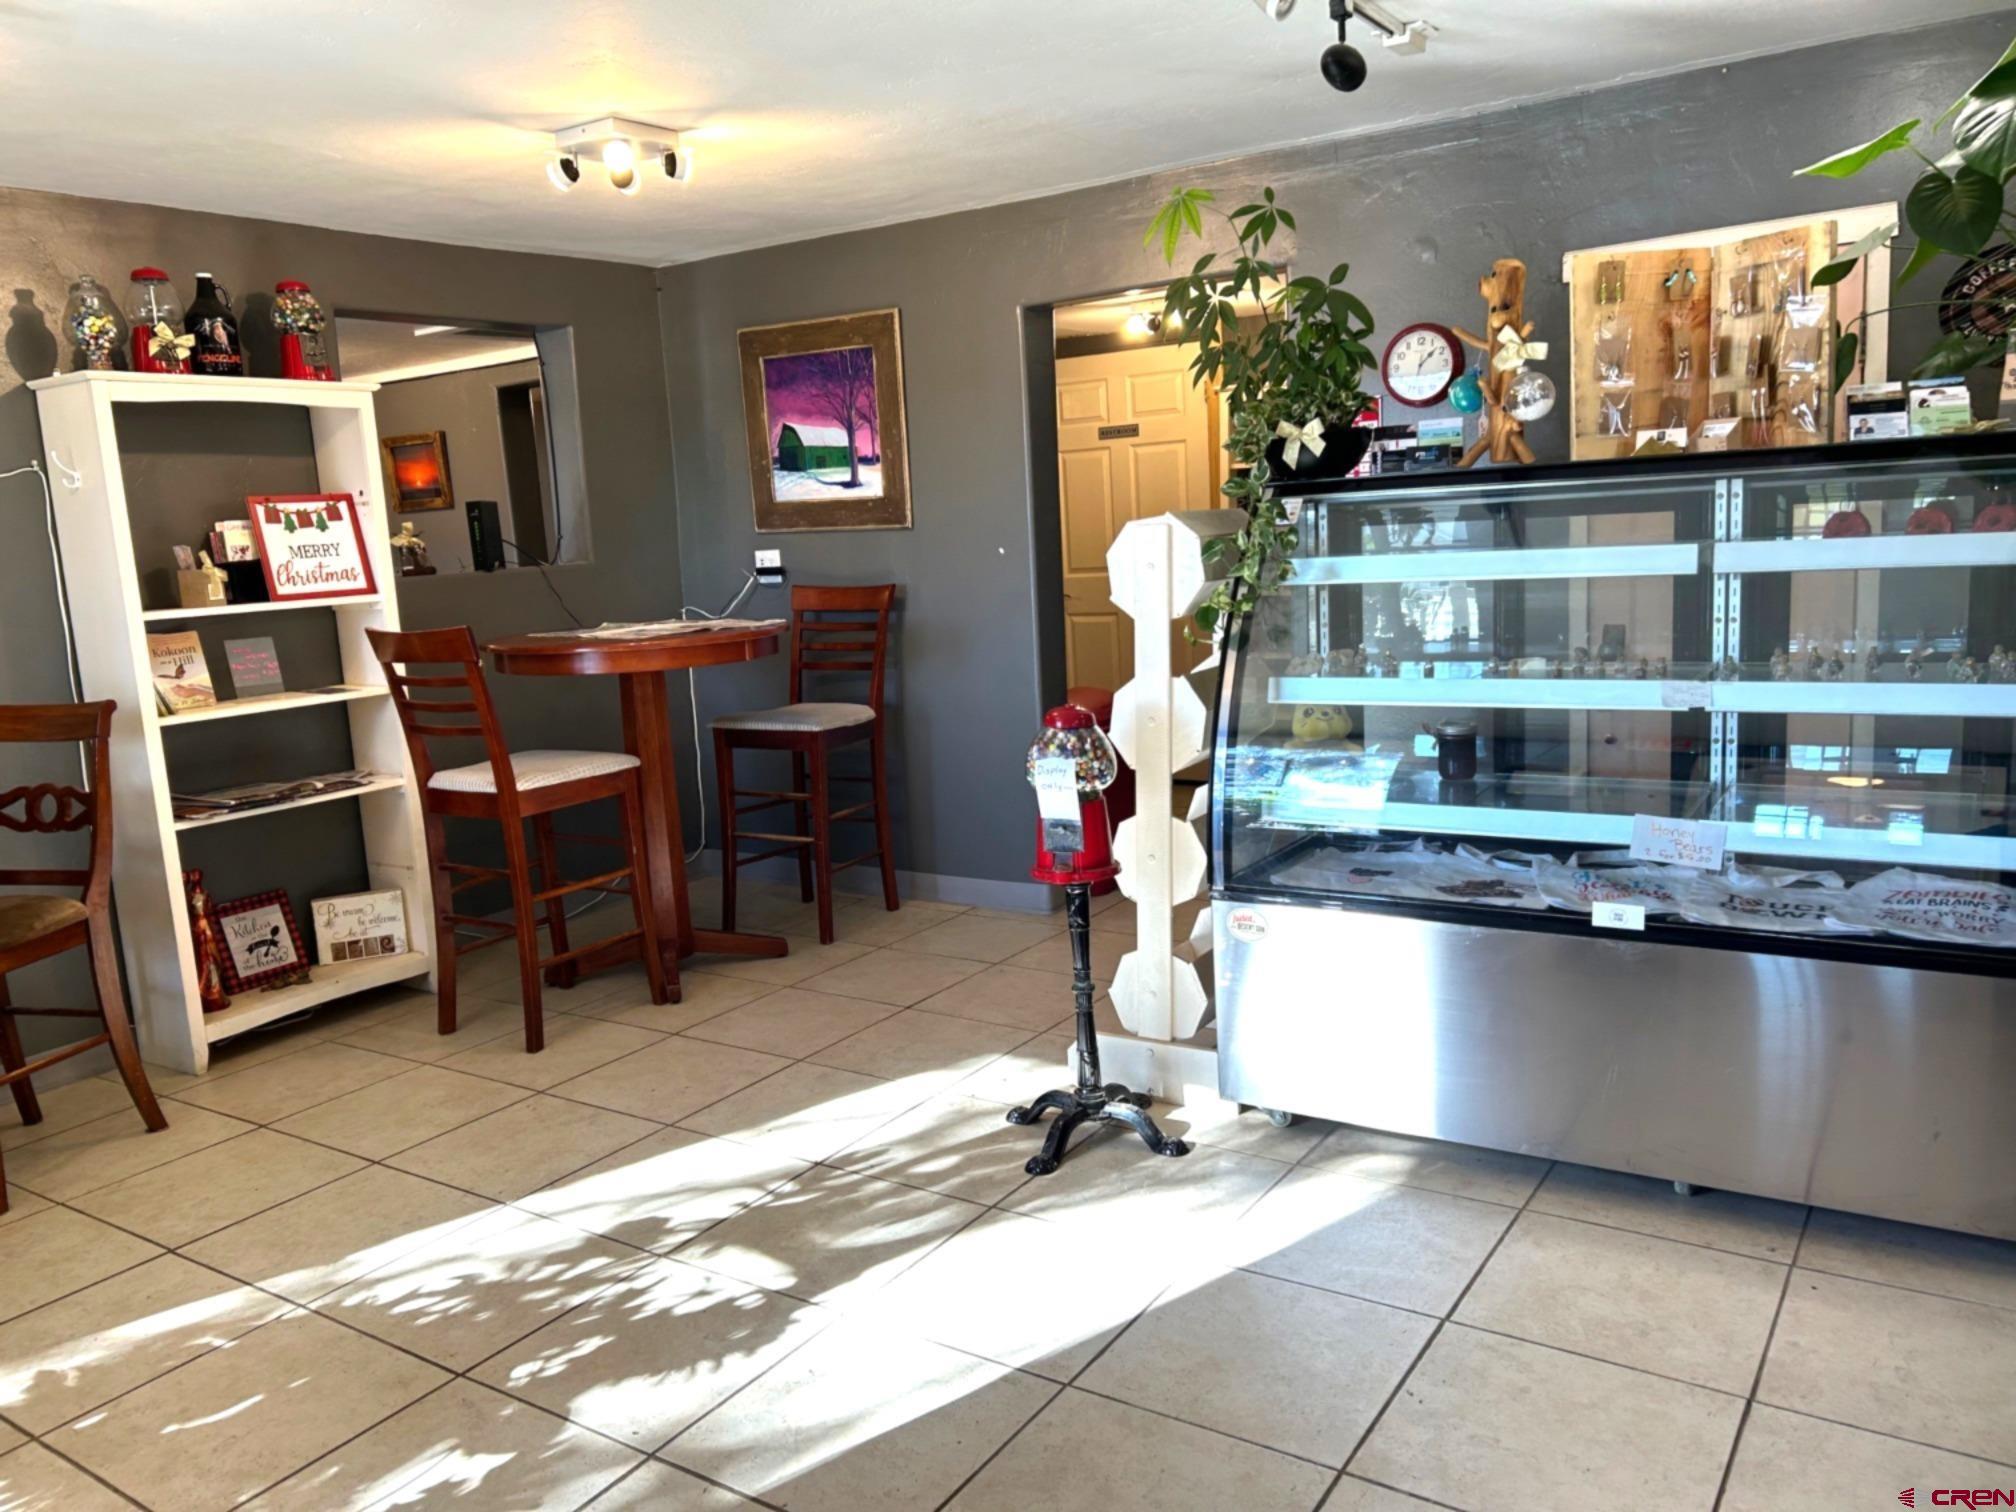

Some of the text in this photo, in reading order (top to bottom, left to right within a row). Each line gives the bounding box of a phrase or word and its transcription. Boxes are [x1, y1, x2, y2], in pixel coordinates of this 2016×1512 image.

[1416, 336, 1426, 345] 12
[1397, 352, 1406, 360] 10
[1439, 346, 1445, 355] 2
[1393, 364, 1399, 373] 9
[288, 542, 340, 559] MERRY
[276, 560, 360, 587] Christmas
[152, 645, 196, 658] Kokoon
[173, 655, 194, 666] Hill
[1651, 822, 1696, 842] Honey
[1671, 839, 1713, 857] Bears
[1927, 898, 1992, 910] BRAINS
